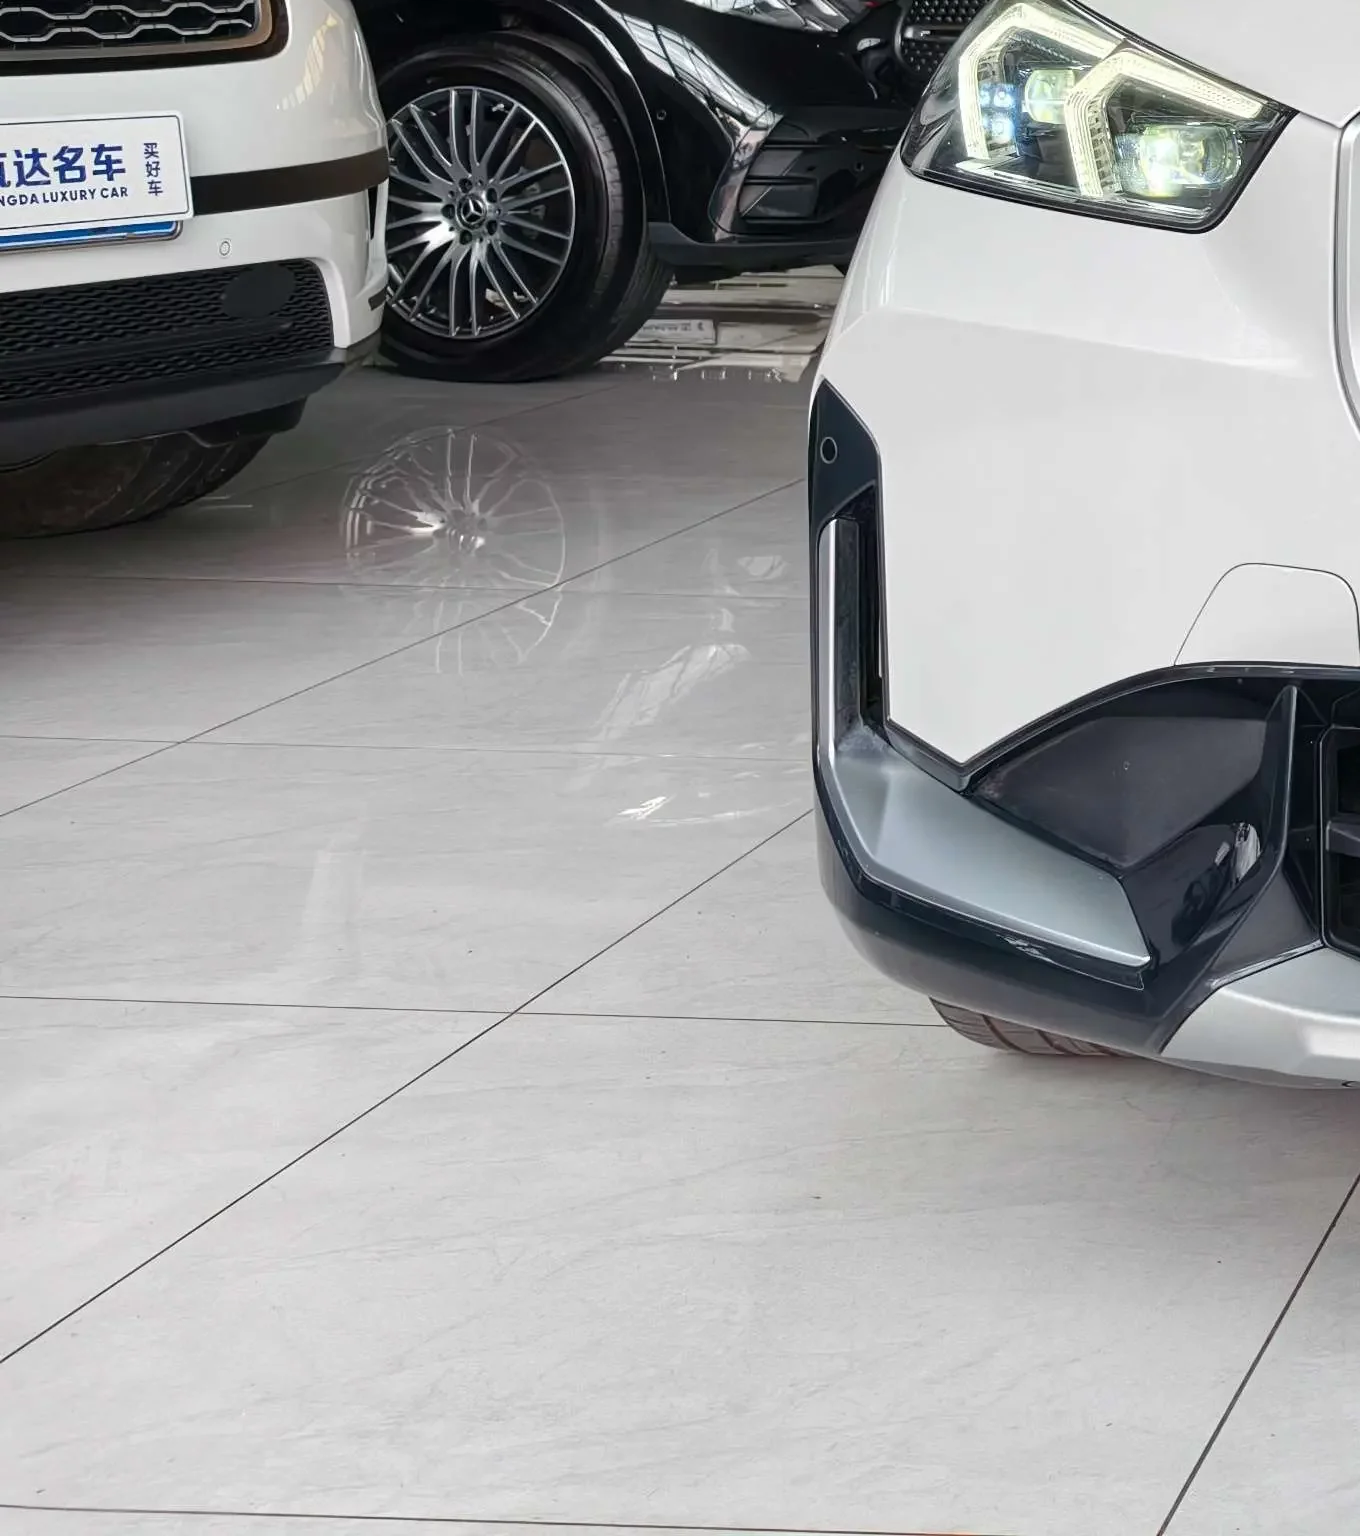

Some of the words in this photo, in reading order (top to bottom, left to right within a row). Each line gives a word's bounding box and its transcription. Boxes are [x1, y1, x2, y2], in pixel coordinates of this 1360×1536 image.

[143, 142, 164, 197] 买好车
[42, 188, 96, 204] LUXURY
[100, 186, 129, 199] CAR
